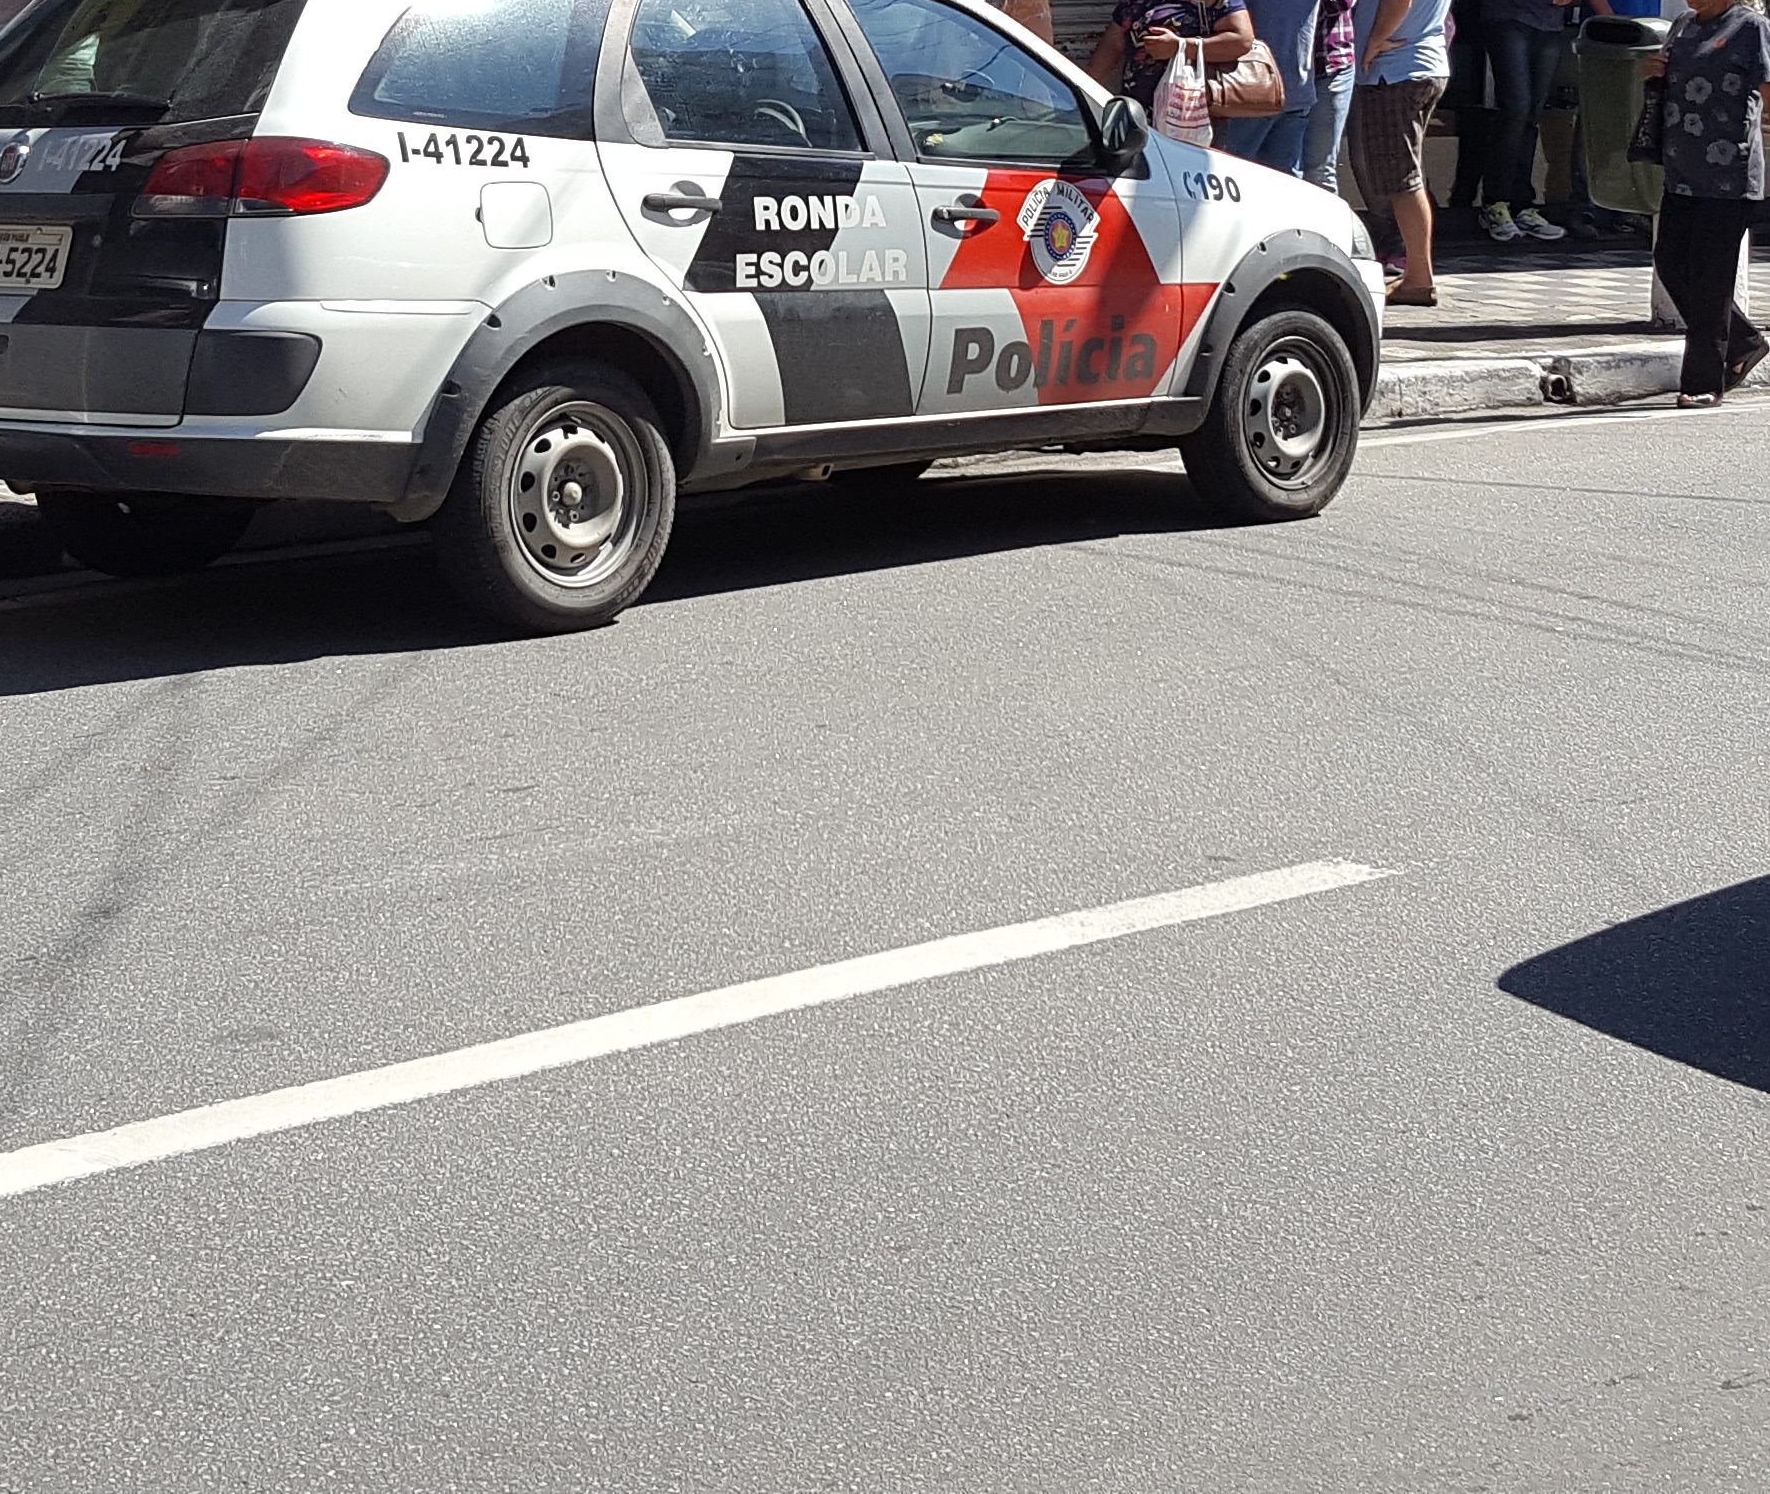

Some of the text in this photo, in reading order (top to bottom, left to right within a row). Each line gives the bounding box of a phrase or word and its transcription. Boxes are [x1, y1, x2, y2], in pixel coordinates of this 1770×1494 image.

[397, 131, 531, 169] I-41224
[1056, 183, 1095, 224] MILITAR
[1194, 173, 1241, 203] 190
[753, 194, 887, 231] RONDA
[735, 249, 908, 288] ESCOLAR
[945, 314, 1158, 396] Polícia
